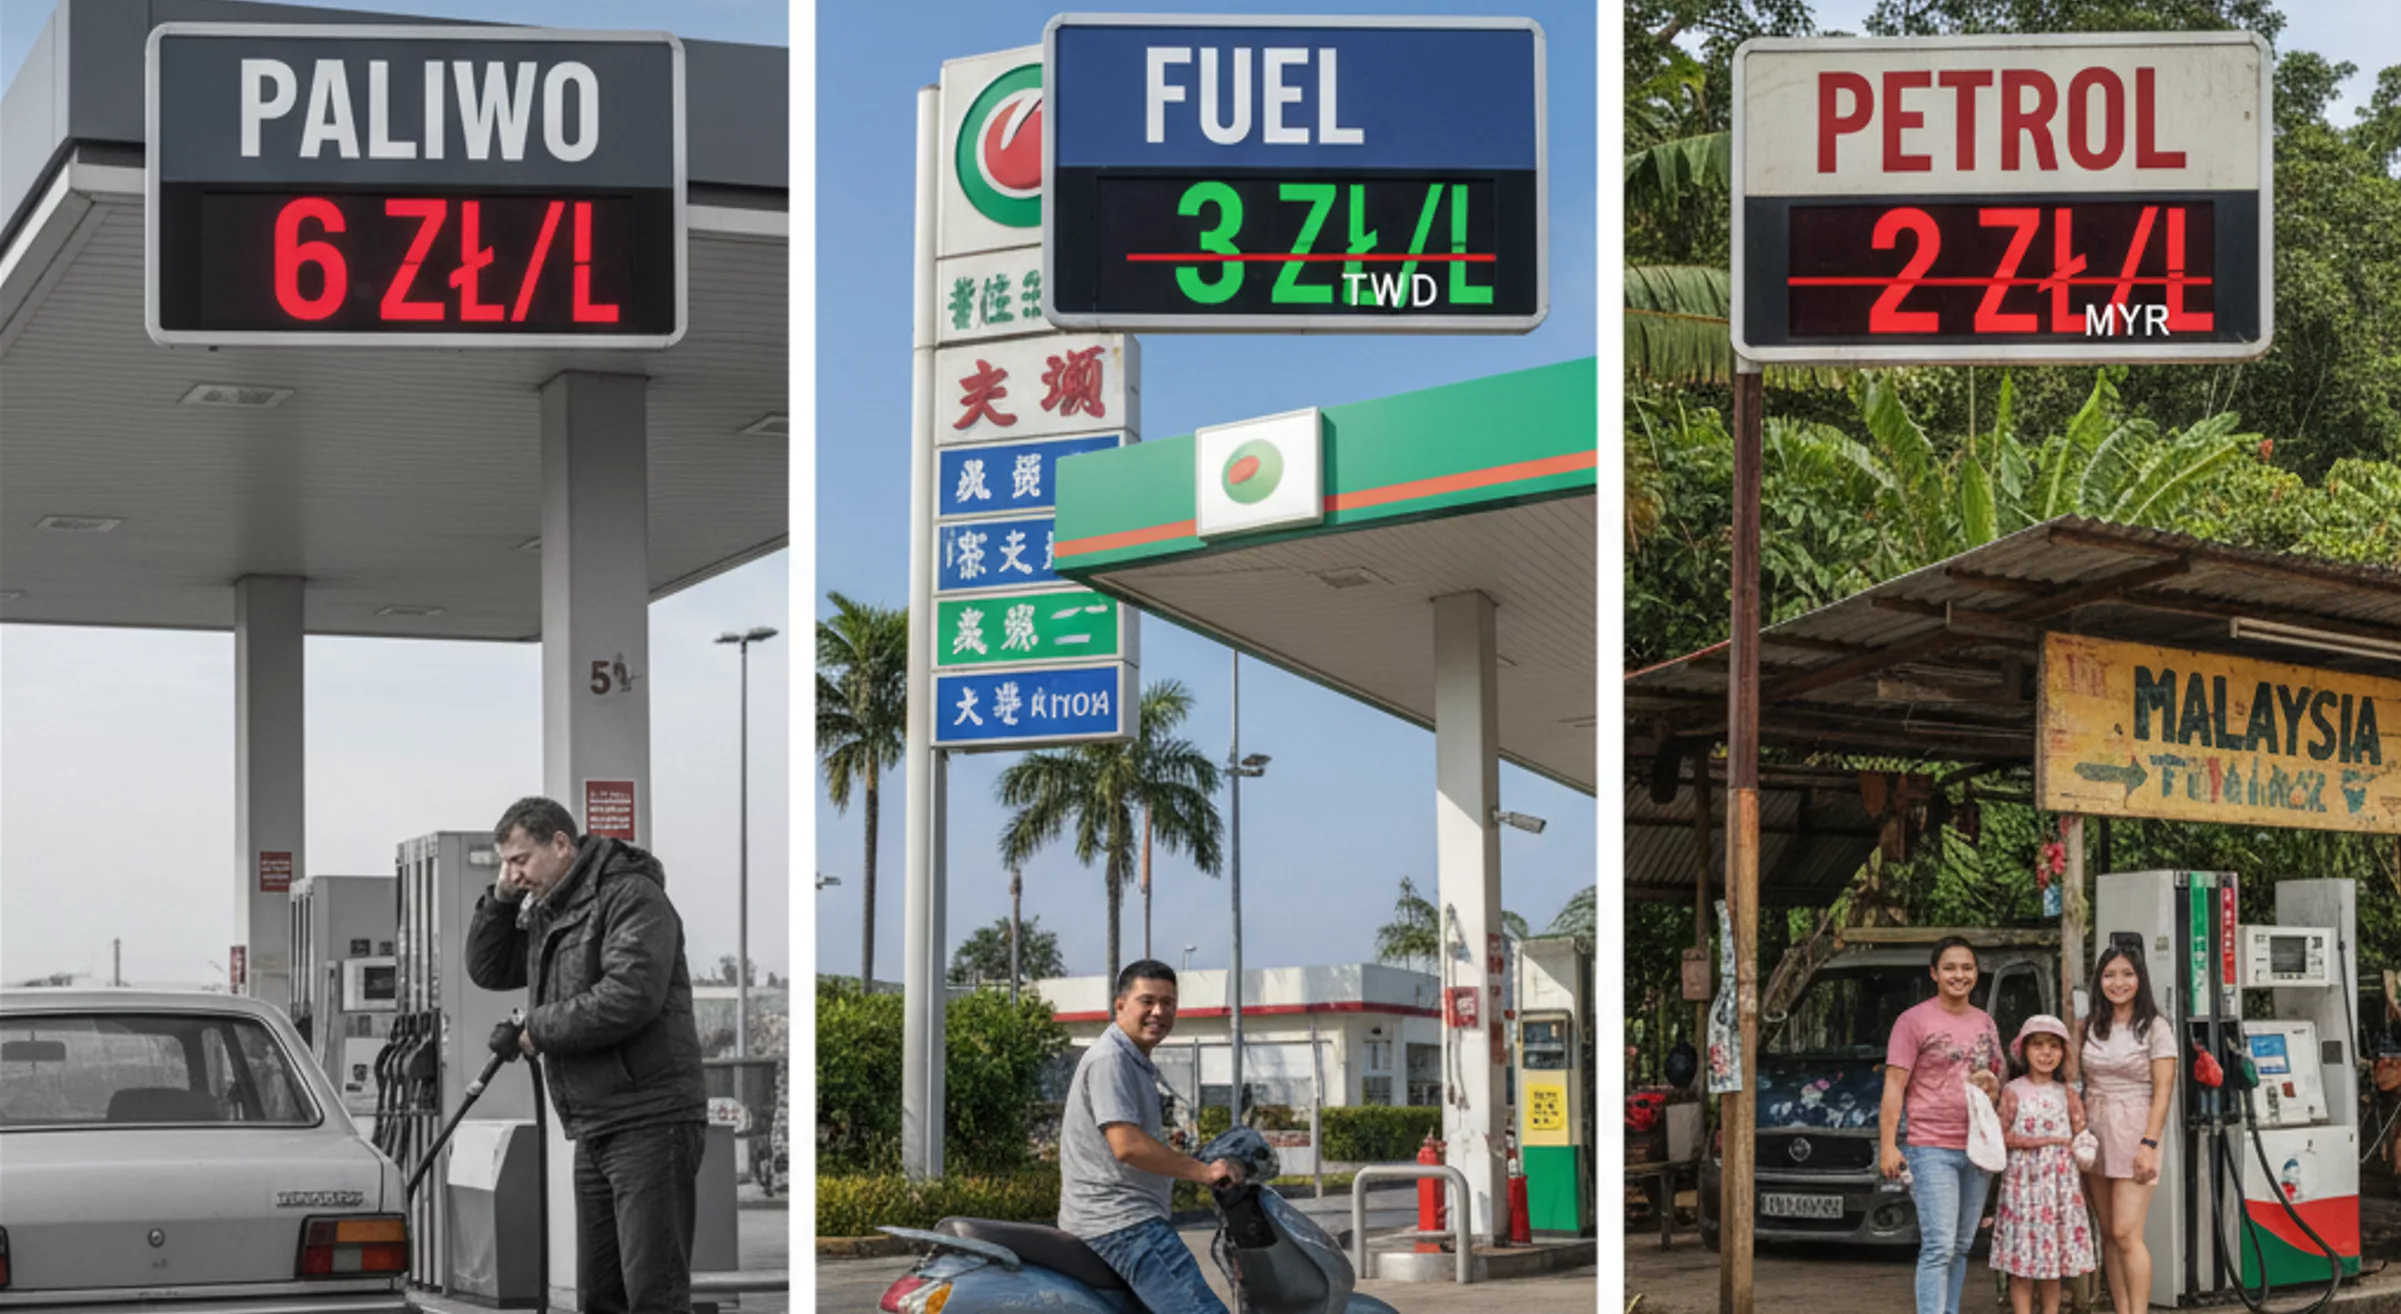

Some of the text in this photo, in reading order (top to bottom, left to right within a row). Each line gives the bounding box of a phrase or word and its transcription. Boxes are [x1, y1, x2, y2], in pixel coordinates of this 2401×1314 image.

[241, 58, 600, 162] PALIWO
[1145, 47, 1364, 145] FUEL
[1817, 66, 2187, 173] PETROL
[274, 197, 619, 323] 6 ZŁ/L
[1175, 181, 1246, 304] 3
[1271, 183, 1493, 307] ZŁ/L
[1868, 206, 2213, 333] 2 ZŁ/L
[2133, 665, 2382, 766] MALAYSIA
